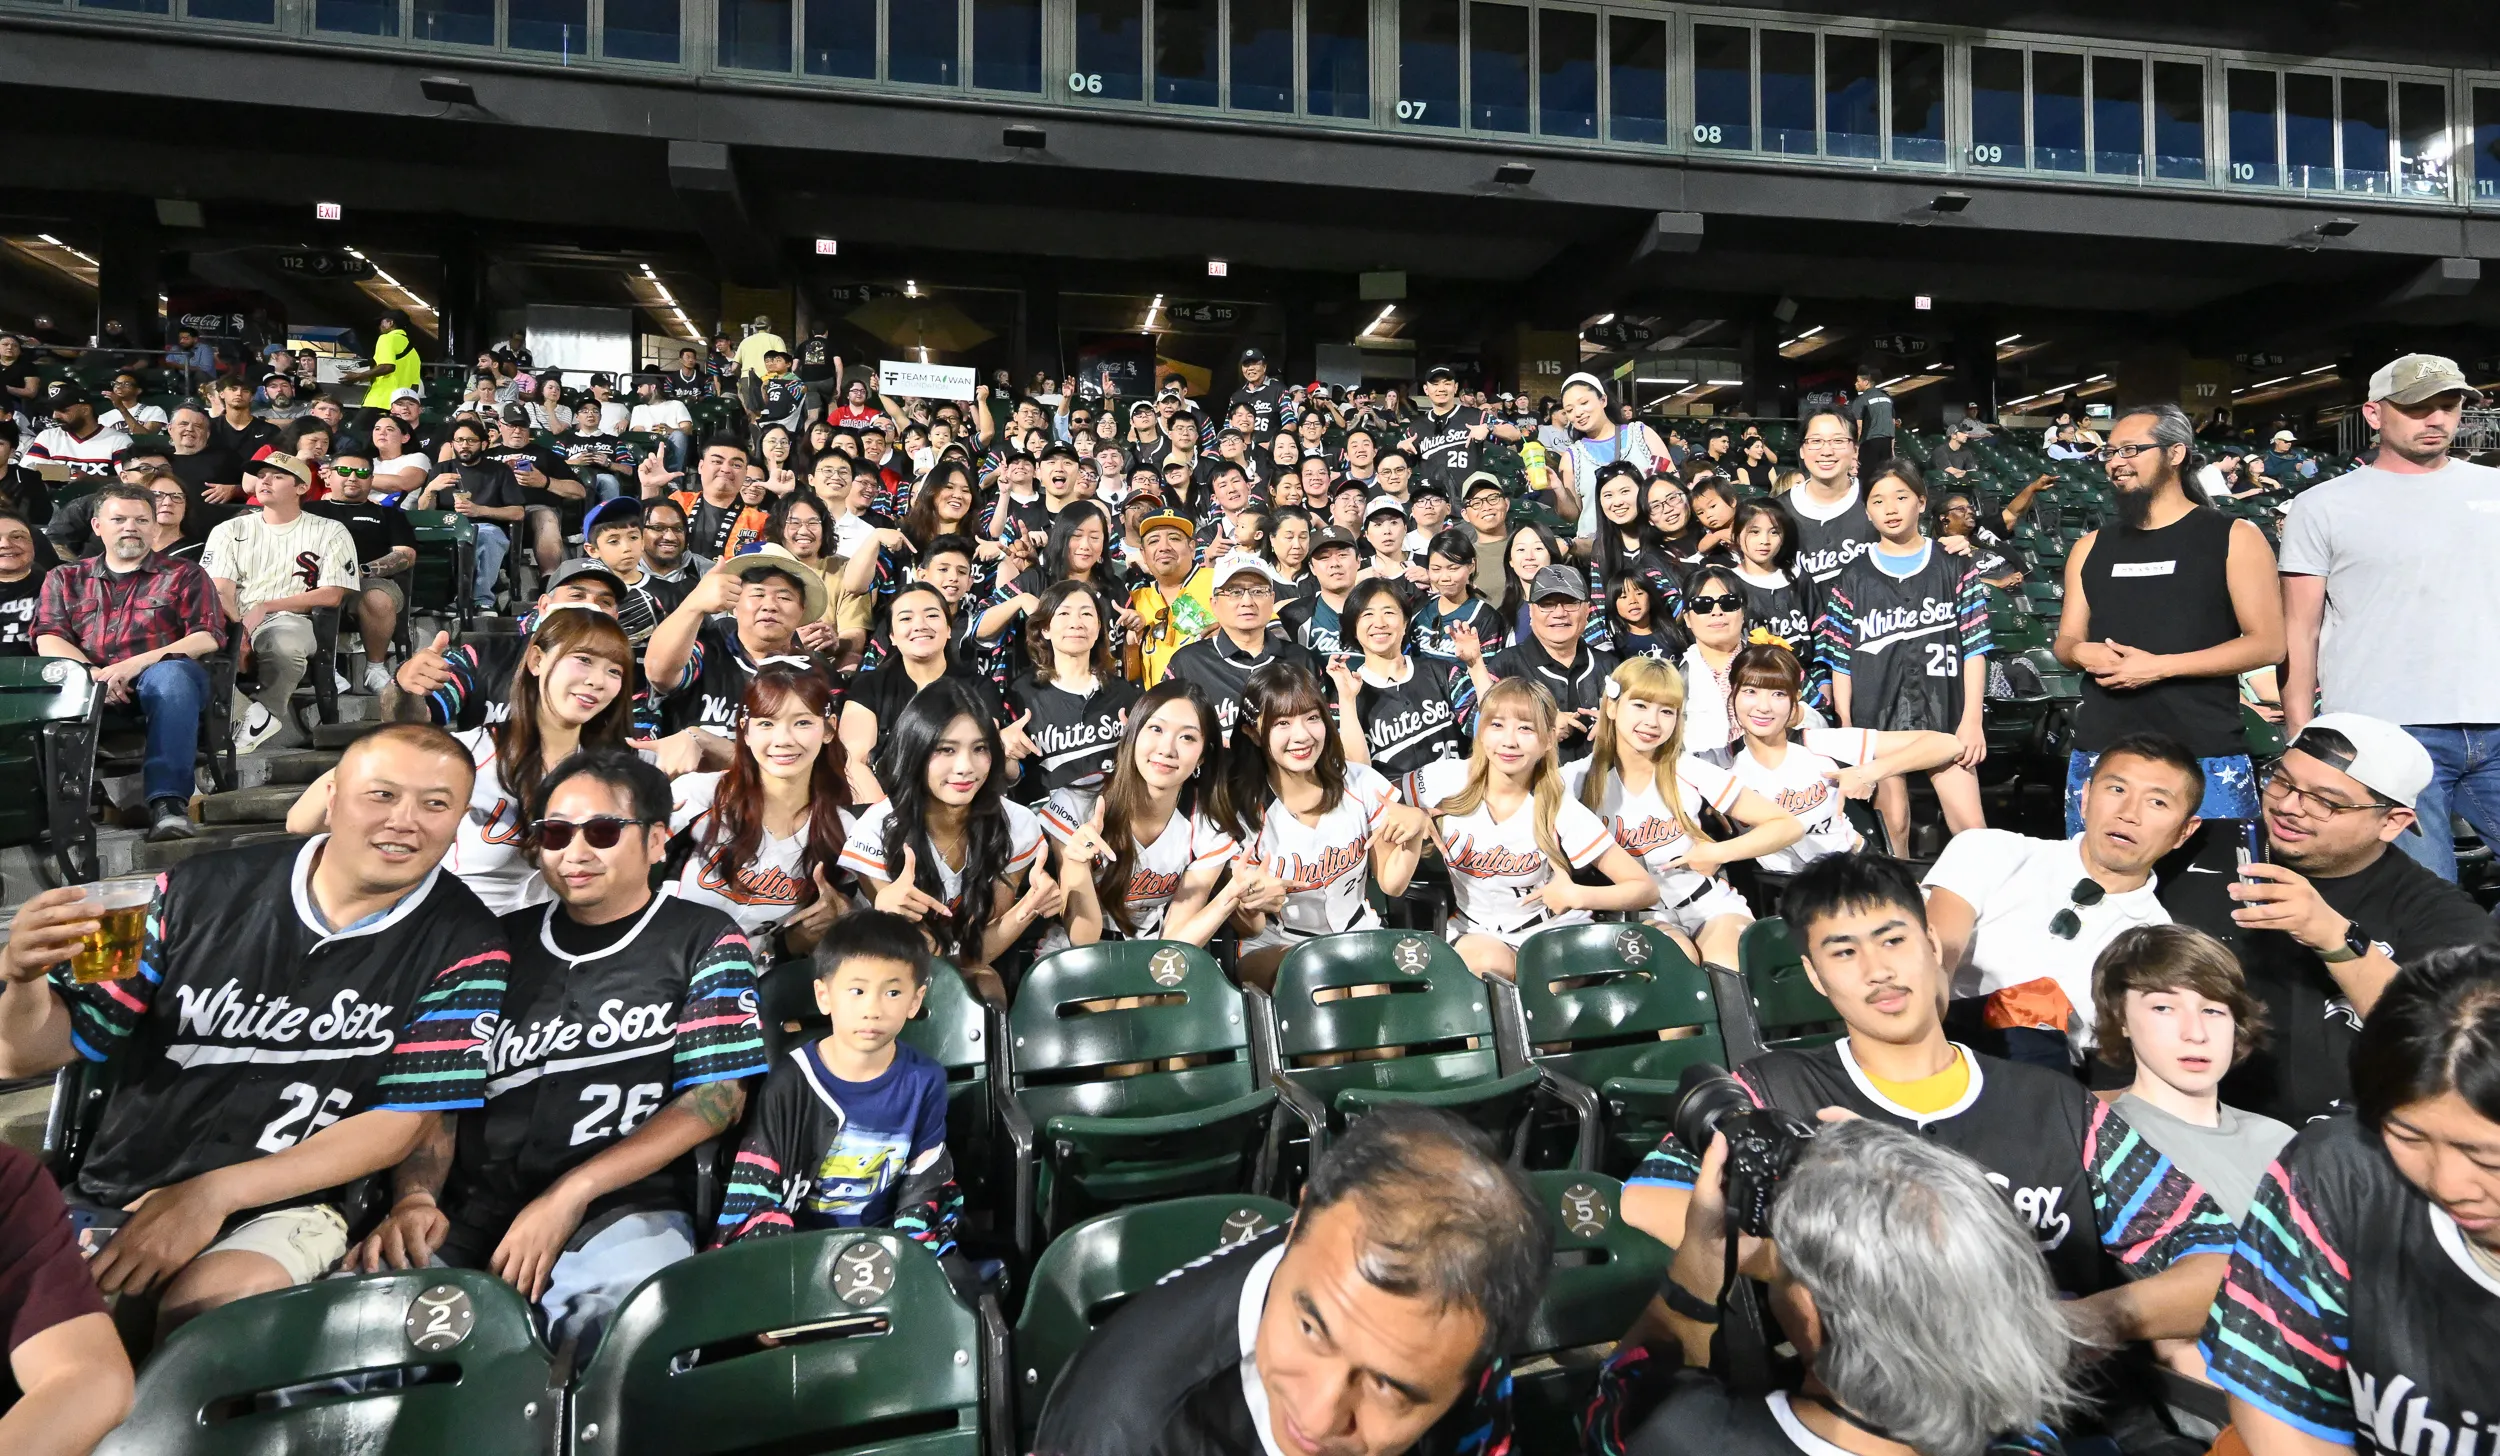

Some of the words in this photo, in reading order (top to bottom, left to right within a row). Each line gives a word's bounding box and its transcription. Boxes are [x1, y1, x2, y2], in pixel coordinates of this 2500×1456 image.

[1069, 73, 1102, 93] 06
[1396, 101, 1427, 119] 07
[1693, 125, 1722, 143] 08
[1975, 145, 2002, 163] 09
[2233, 163, 2254, 180] 10
[2479, 180, 2494, 196] 11
[319, 205, 339, 219] EXIT
[817, 241, 835, 254] EXIT
[283, 257, 303, 268] 112
[343, 260, 362, 271] 113
[1210, 263, 1226, 276] EXIT
[832, 289, 849, 299] 113
[1916, 297, 1930, 309] EXIT
[1174, 308, 1190, 317] 114
[1216, 309, 1232, 319] 115
[1536, 361, 1561, 375] 115
[901, 373, 927, 382] TEAM
[769, 391, 780, 401] 26
[2196, 383, 2217, 397] 117
[1254, 417, 1269, 432] 26
[1446, 429, 1468, 442] Sox
[595, 441, 613, 454] Sox
[1448, 451, 1468, 468] 26
[1163, 509, 1174, 518] B
[1852, 604, 1918, 642] White
[1919, 597, 1957, 625] Sox
[1925, 643, 1958, 677] 26
[1366, 711, 1423, 748] White
[1031, 722, 1096, 753] White
[1404, 948, 1418, 963] 5
[1627, 941, 1640, 955] 6
[1162, 960, 1176, 975] 4
[176, 978, 311, 1042] White
[309, 988, 395, 1055] Sox
[587, 999, 678, 1048] Sox
[569, 1083, 664, 1146] 26
[1575, 1200, 1594, 1221] 5
[852, 1262, 874, 1287] 3
[426, 1305, 451, 1333] 2
